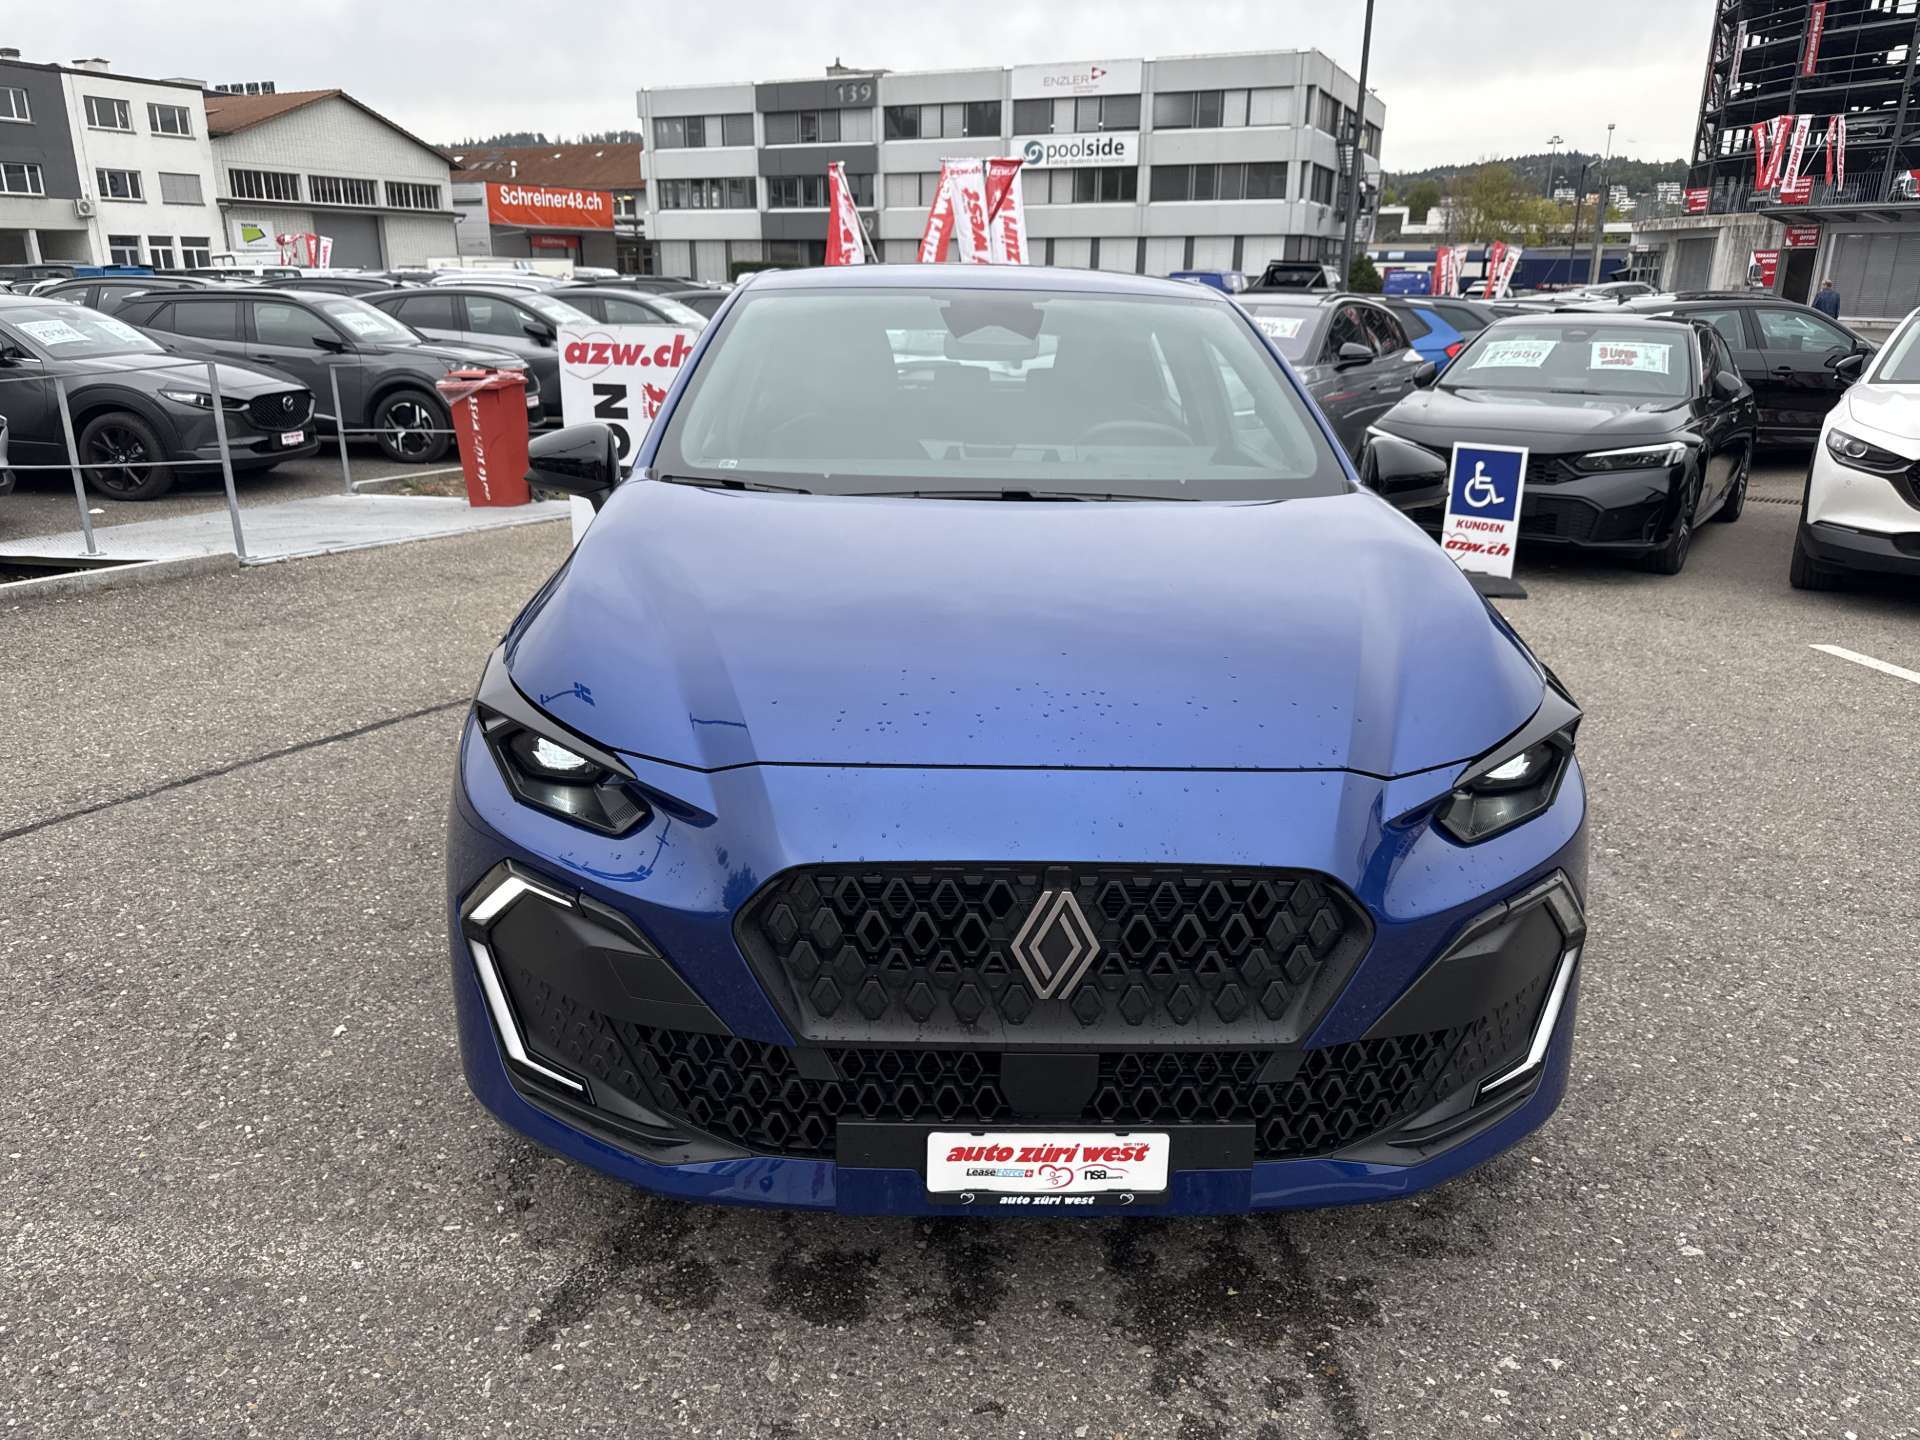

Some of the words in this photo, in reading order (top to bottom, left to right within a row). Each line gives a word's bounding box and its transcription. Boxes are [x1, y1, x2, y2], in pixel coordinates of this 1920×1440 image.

[1043, 75, 1089, 87] ENZLER
[836, 83, 872, 102] 139
[1046, 138, 1125, 165] poolside
[500, 185, 603, 210] Schreiner48.ch
[962, 188, 988, 251] west
[999, 214, 1021, 264] züri
[565, 335, 693, 368] azw.ch
[468, 395, 480, 430] west
[1456, 519, 1505, 534] KUNDEN
[1444, 539, 1511, 557] azw.ch
[946, 1144, 1014, 1162] auto
[1015, 1143, 1080, 1162] züri
[1082, 1144, 1150, 1162] west
[1084, 1169, 1106, 1180] nsa
[1000, 1195, 1030, 1205] auto
[1033, 1195, 1062, 1205] züri
[1064, 1196, 1095, 1205] west
